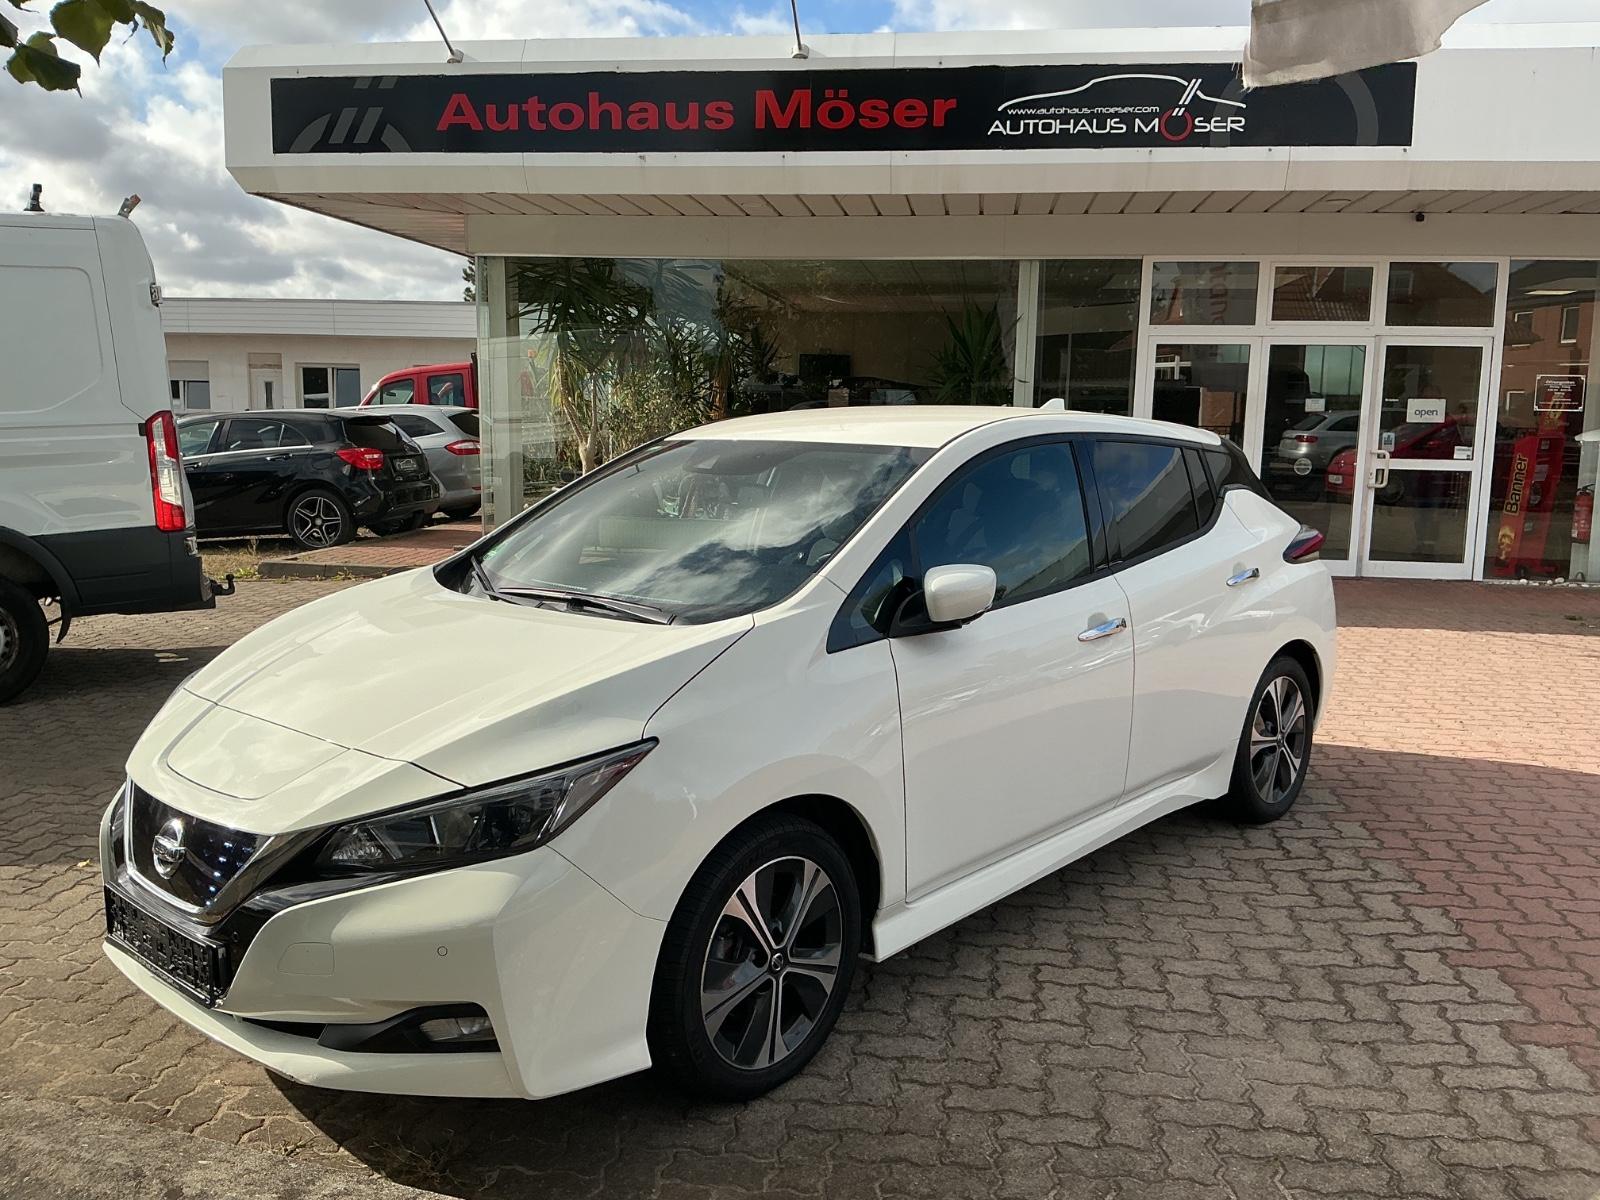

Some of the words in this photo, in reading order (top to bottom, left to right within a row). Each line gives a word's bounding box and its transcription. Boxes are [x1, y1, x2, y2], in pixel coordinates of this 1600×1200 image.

[436, 92, 734, 131] Autohaus
[755, 88, 957, 129] Möser
[988, 118, 1127, 135] AUTOHAUS
[1135, 107, 1246, 141] MÖSER
[1007, 106, 1159, 115] www.autohaus-moeser.com
[1414, 409, 1438, 418] open
[1503, 453, 1528, 516] Banner
